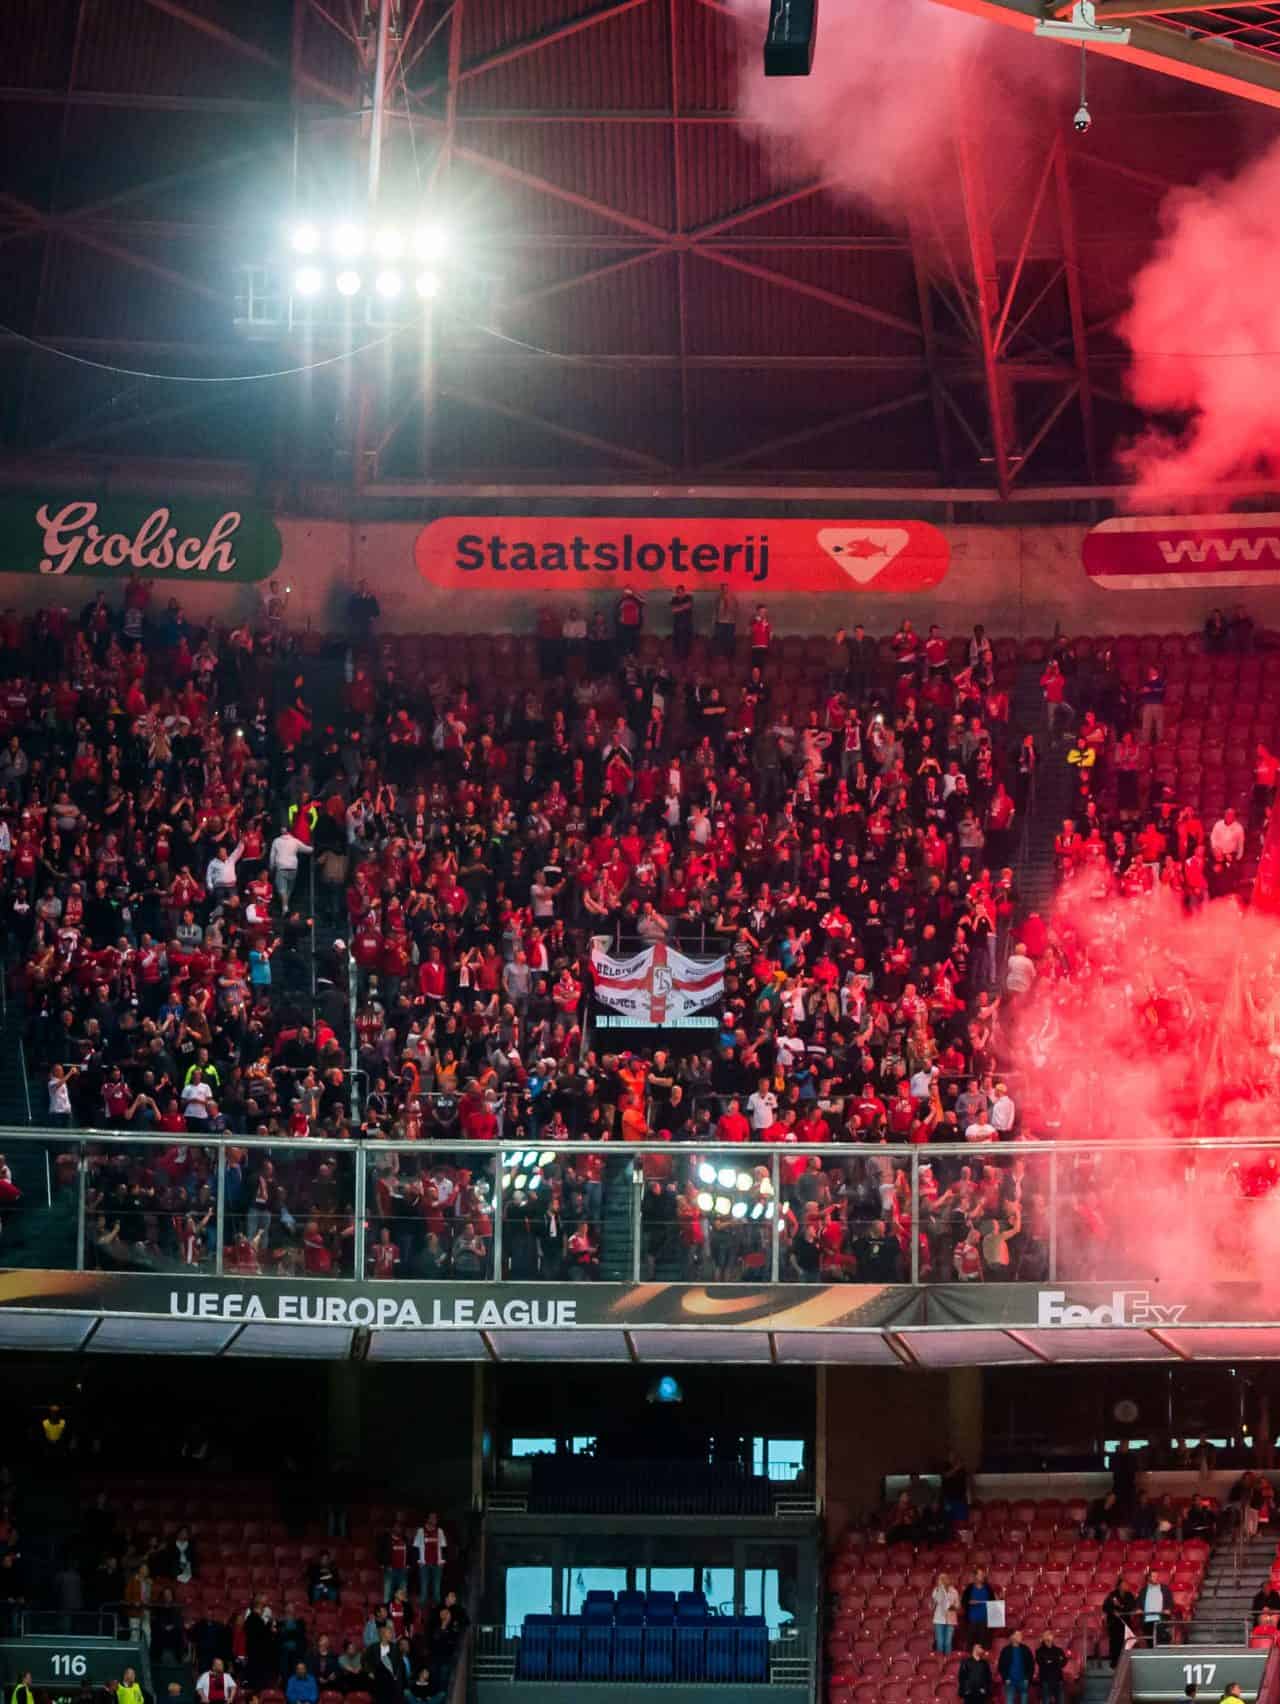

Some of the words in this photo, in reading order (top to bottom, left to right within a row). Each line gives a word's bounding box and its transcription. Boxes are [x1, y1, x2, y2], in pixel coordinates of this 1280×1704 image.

[35, 502, 241, 575] Grolsch
[455, 534, 770, 582] Staatsloterij
[169, 1292, 268, 1319] UEFA
[278, 1295, 423, 1326] EUROPA
[432, 1299, 577, 1326] LEAGUE
[1038, 1290, 1187, 1326] FedEx
[51, 1653, 87, 1676] 116
[1183, 1664, 1217, 1685] 117
